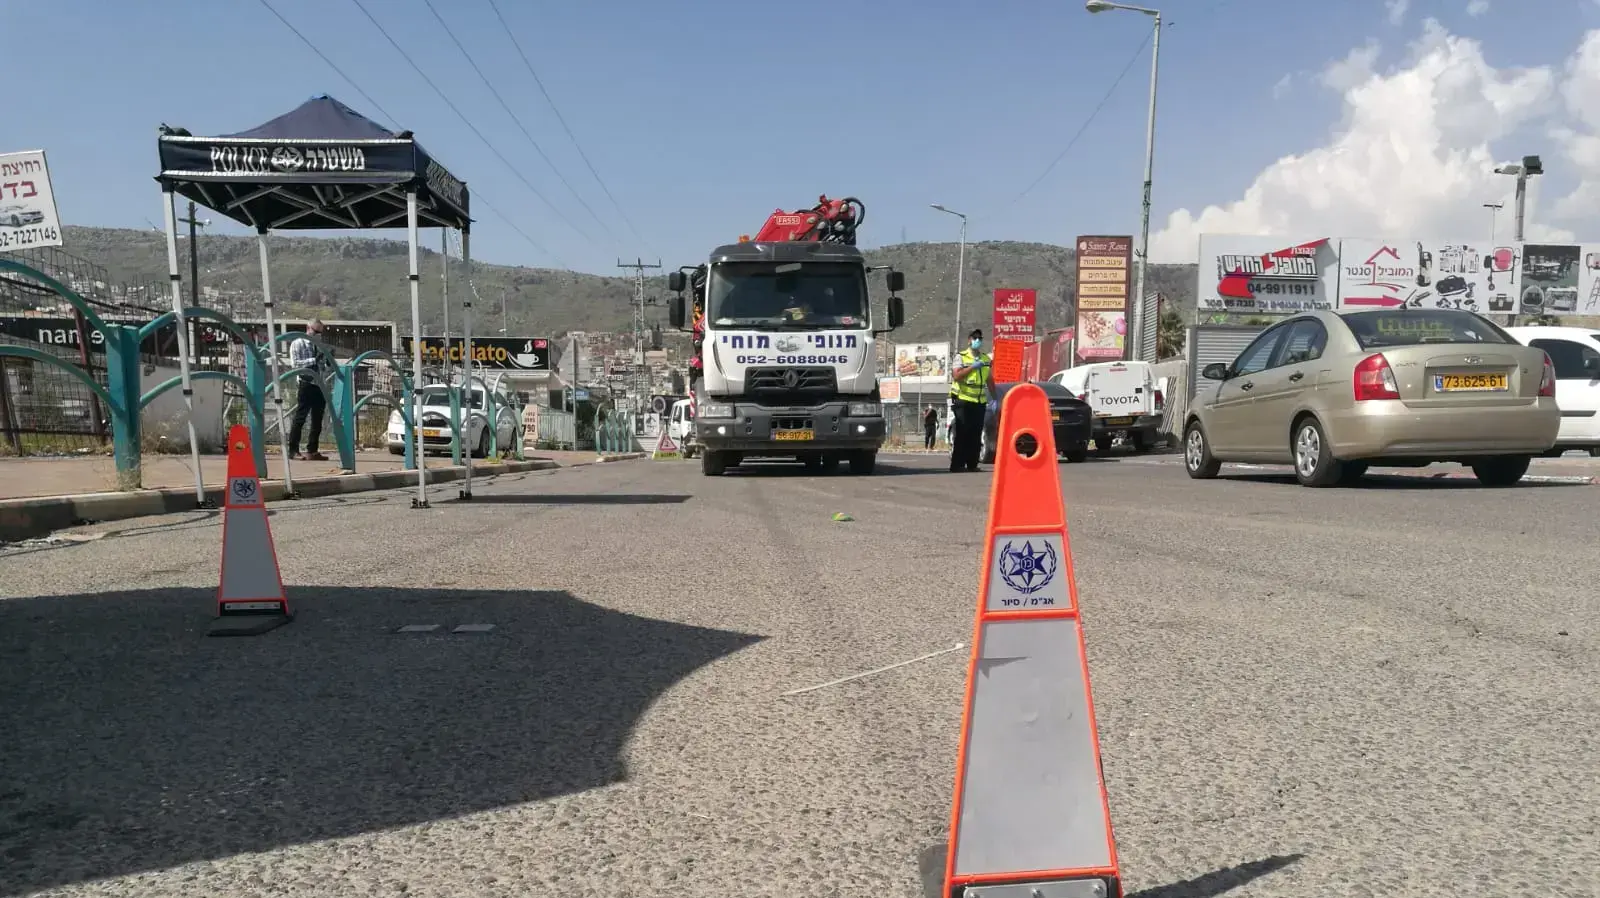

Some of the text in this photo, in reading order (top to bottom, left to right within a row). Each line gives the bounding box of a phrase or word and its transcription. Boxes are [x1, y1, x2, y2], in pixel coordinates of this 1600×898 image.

[210, 146, 271, 172] POLICE
[306, 147, 366, 170] משטרה
[2, 160, 41, 176] רחיצת
[1345, 266, 1414, 277] המוביל סנטר
[1247, 283, 1316, 295] 04-9911911
[723, 335, 857, 349] מנופי מוחי
[737, 355, 848, 364] 052-6088046
[1100, 396, 1140, 405] TOYOTA
[1001, 598, 1020, 606] סיור
